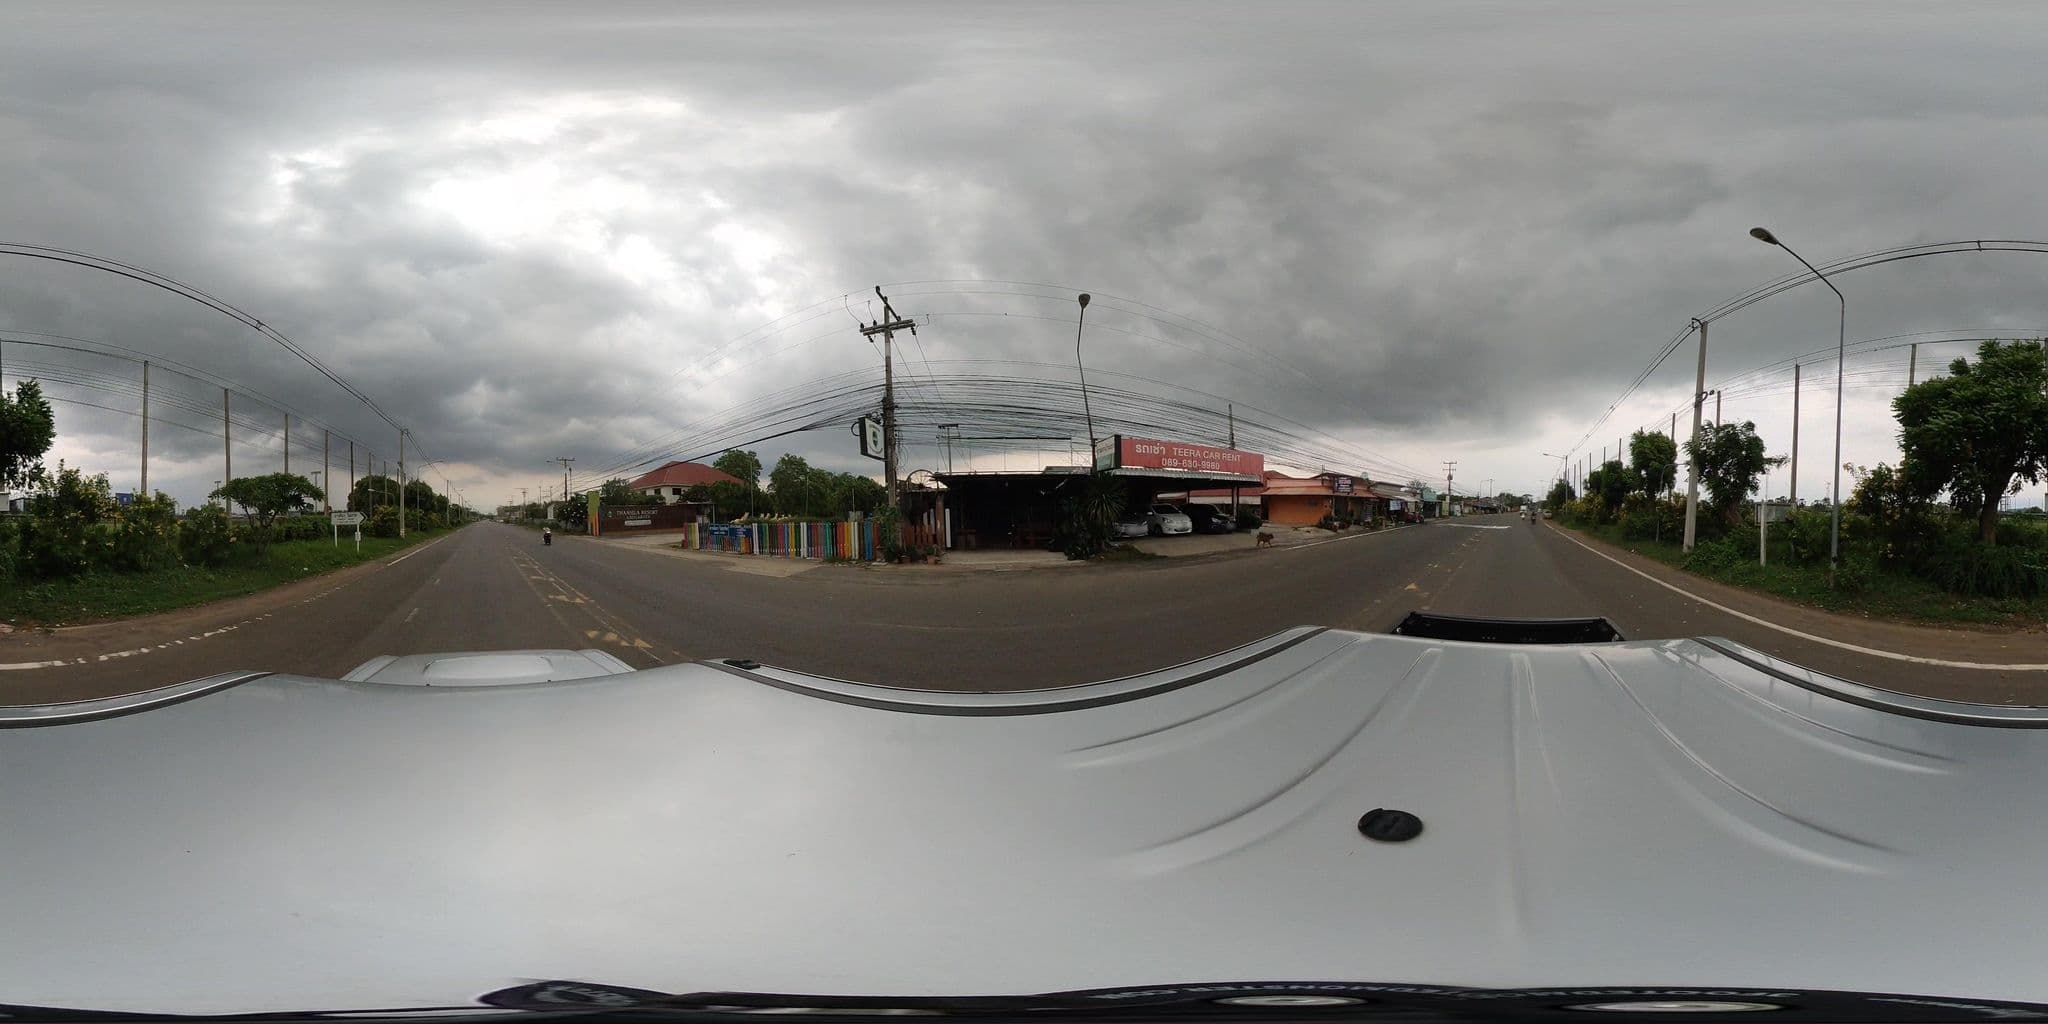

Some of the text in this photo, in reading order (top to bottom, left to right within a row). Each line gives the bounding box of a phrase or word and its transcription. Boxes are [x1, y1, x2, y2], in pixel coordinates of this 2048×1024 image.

[1135, 443, 1166, 455] รถเช่า
[1173, 447, 1242, 462] TEERA CAR RENT
